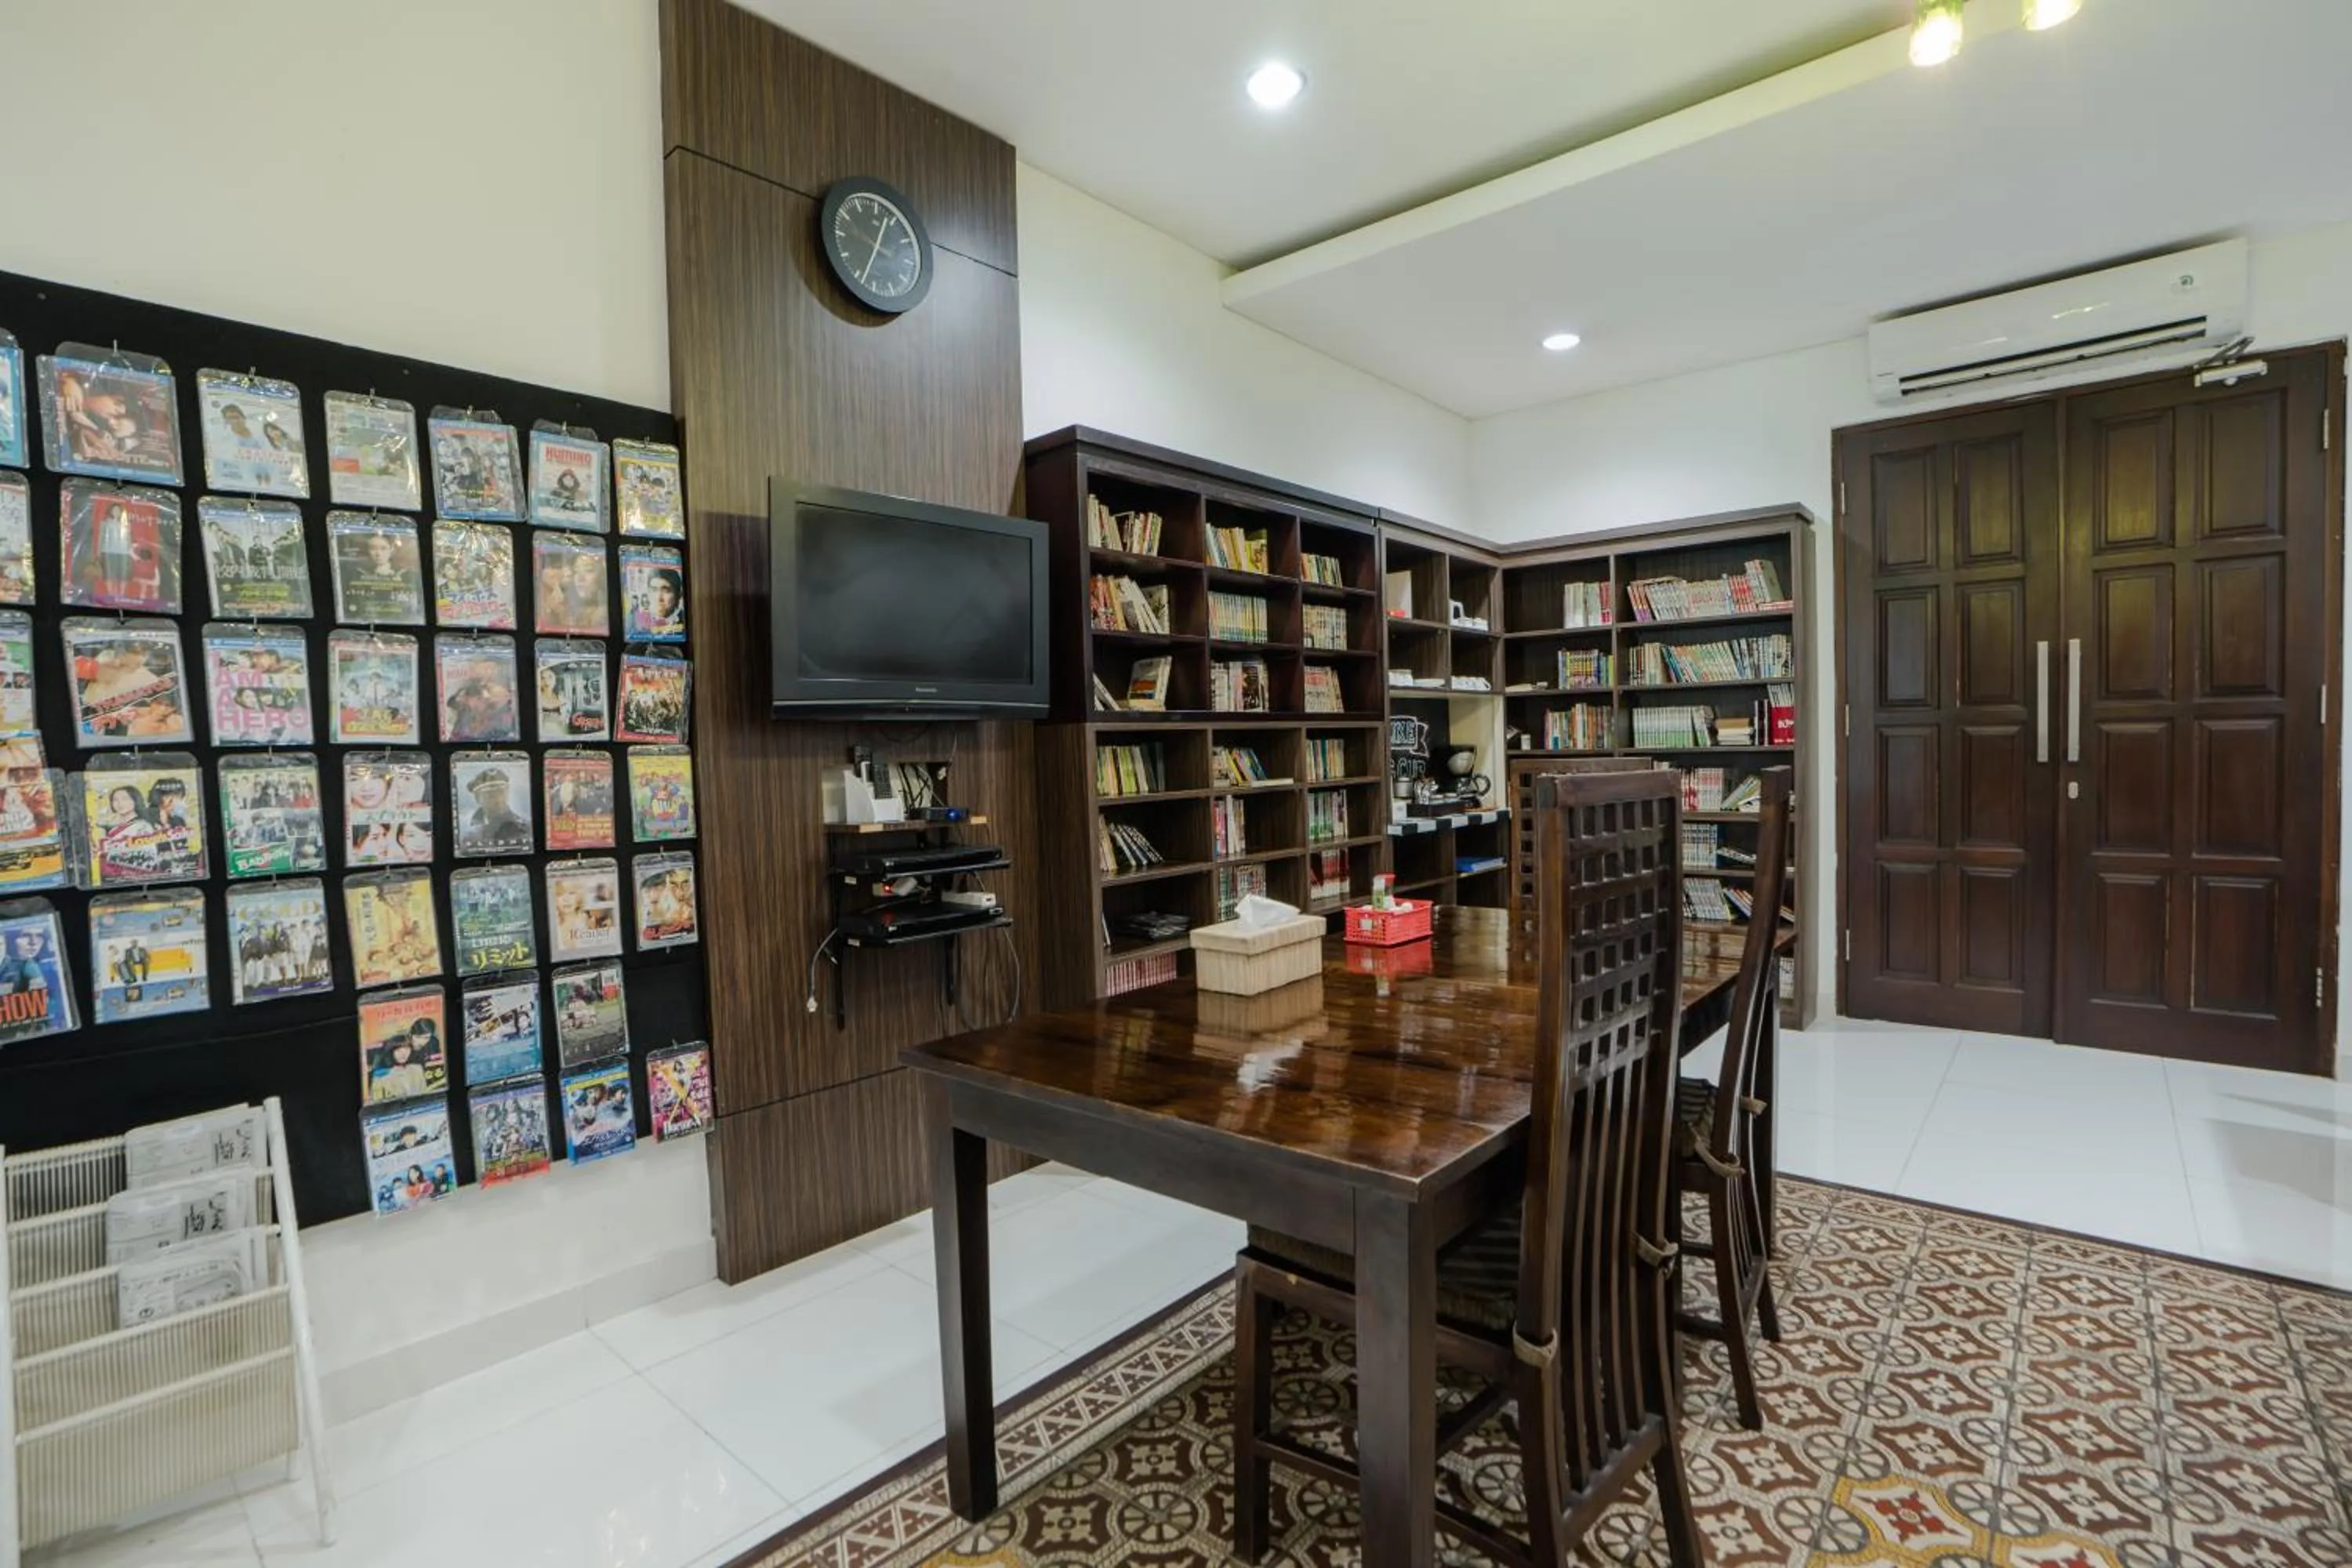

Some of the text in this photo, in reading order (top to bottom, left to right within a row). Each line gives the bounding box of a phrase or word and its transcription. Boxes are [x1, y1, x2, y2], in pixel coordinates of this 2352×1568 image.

[216, 670, 263, 688] AM
[216, 688, 234, 706] A
[217, 707, 309, 731] HERO
